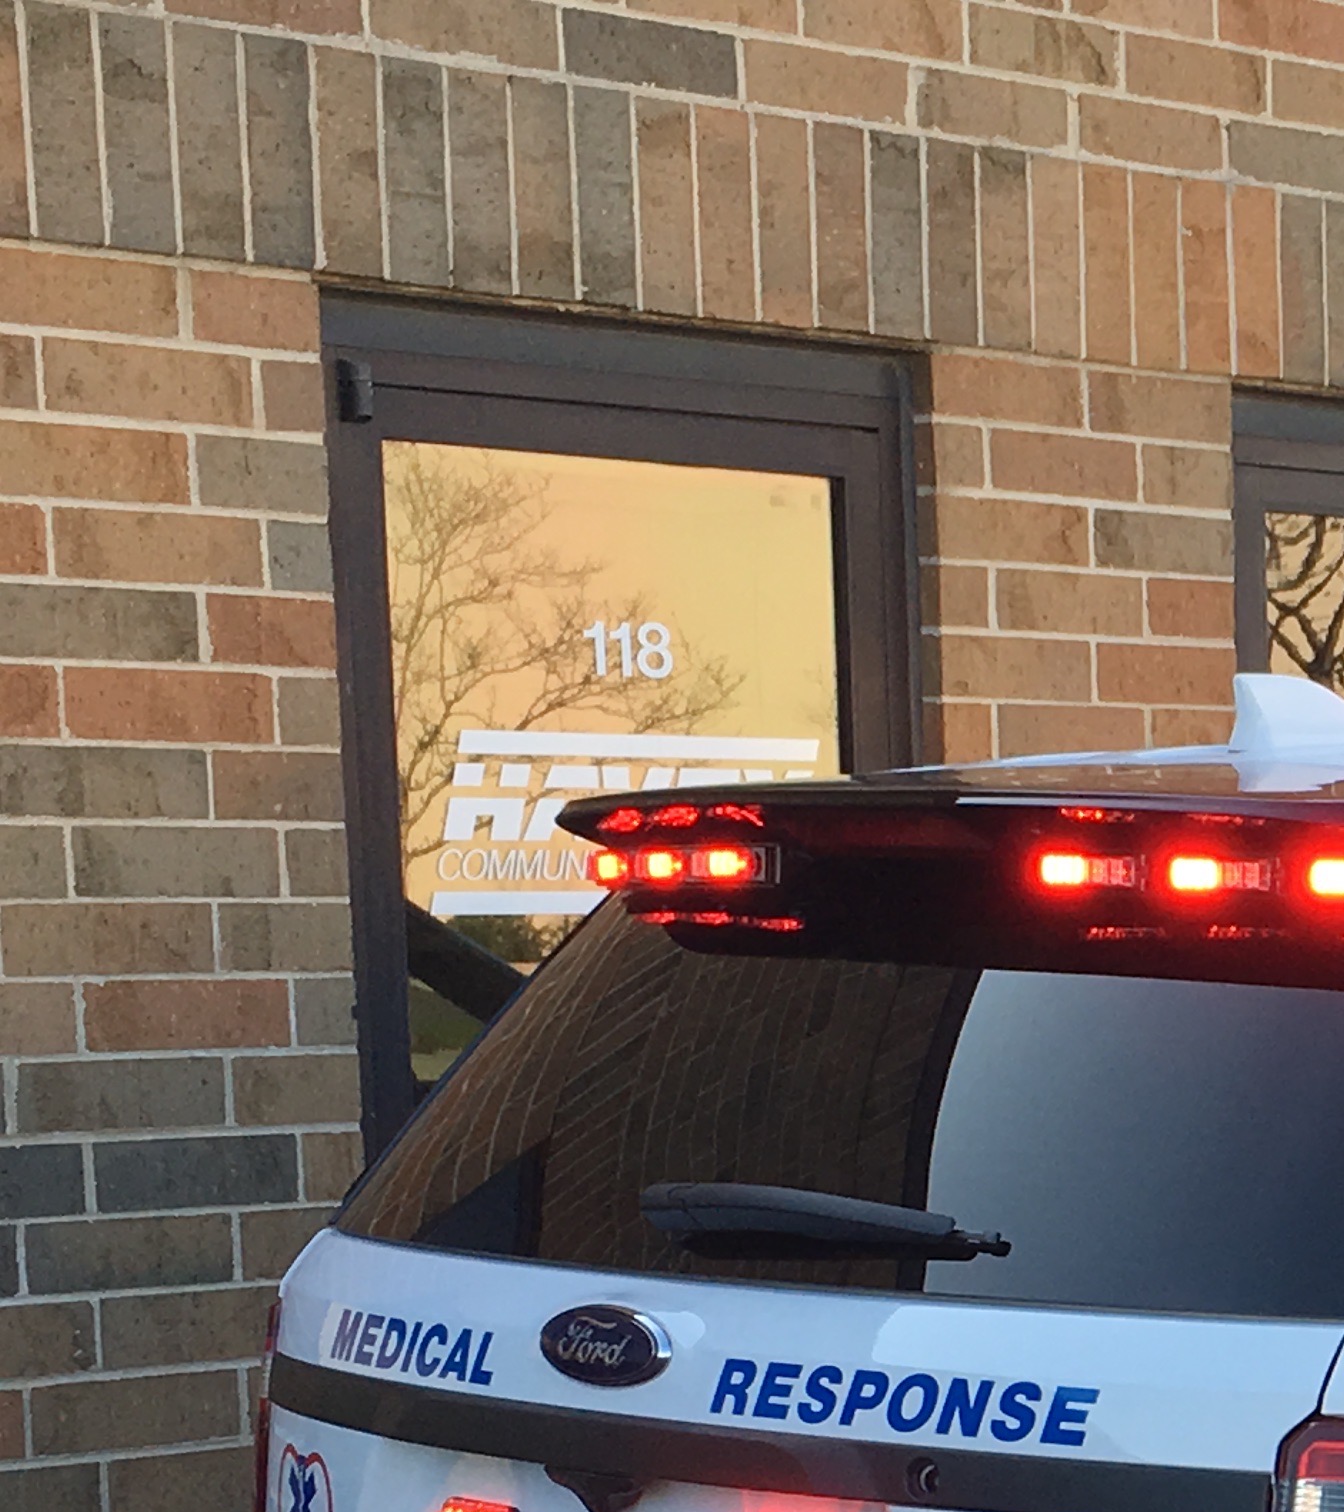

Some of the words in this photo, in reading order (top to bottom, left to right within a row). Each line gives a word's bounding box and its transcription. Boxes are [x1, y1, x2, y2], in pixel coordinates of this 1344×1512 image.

[583, 620, 673, 680] 118
[436, 847, 590, 882] COMMUN
[558, 1315, 632, 1369] Ford
[331, 1308, 495, 1386] MEDICAL
[709, 1358, 1101, 1446] RESPONSE
